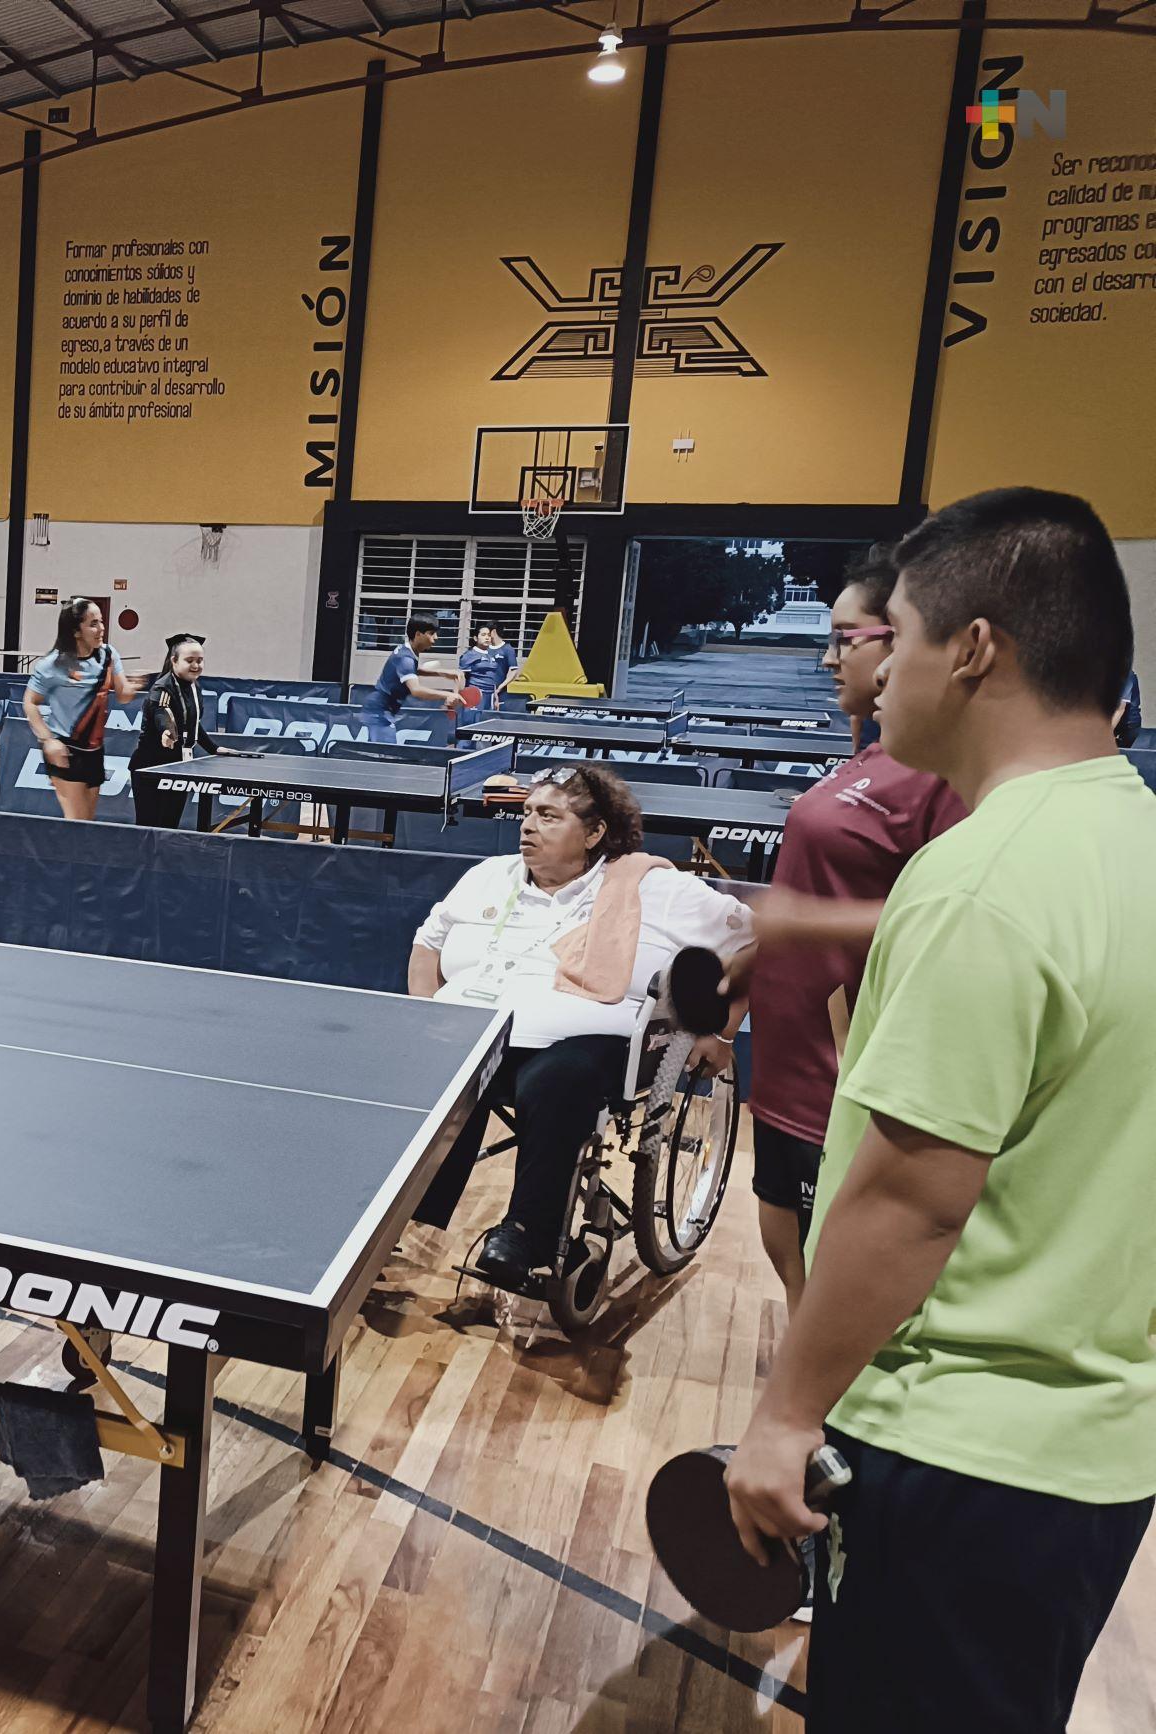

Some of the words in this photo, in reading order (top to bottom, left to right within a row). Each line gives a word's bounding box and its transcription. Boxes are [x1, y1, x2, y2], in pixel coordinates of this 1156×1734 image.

[1052, 152, 1082, 176] Ser
[1048, 182, 1107, 206] calidad
[1113, 182, 1133, 202] de
[1041, 213, 1140, 241] programas
[66, 241, 107, 258] Formar
[112, 239, 184, 261] profesionales
[189, 240, 209, 255] con
[1039, 242, 1127, 271] egresados
[147, 263, 183, 280] sólidos
[188, 265, 195, 284] y
[1034, 277, 1064, 295] con
[1072, 271, 1087, 293] el
[64, 290, 102, 306] dominio
[107, 289, 119, 305] de
[124, 287, 181, 305] habilidades
[187, 287, 200, 303] de
[62, 312, 107, 329] acuerdo
[111, 315, 119, 328] a
[123, 314, 135, 329] su
[140, 309, 171, 334] perfil
[175, 310, 189, 327] de
[1030, 302, 1107, 323] sociedad.
[116, 331, 154, 352] través
[158, 335, 171, 351] de
[176, 337, 188, 351] un
[60, 358, 100, 374] modelo
[104, 357, 159, 374] educativo
[163, 357, 209, 376] integral
[301, 235, 351, 487] MISIÓN
[59, 384, 85, 400] para
[89, 379, 146, 396] contribuir
[151, 378, 160, 395] al
[165, 378, 225, 395] desarrollo
[58, 403, 70, 418] de
[74, 406, 85, 418] su
[89, 402, 124, 418] ámbito
[128, 402, 192, 424] profesional
[781, 719, 818, 728] DONIC
[157, 778, 222, 795] DONIC
[226, 786, 284, 799] WALDNER
[286, 792, 312, 801] 909
